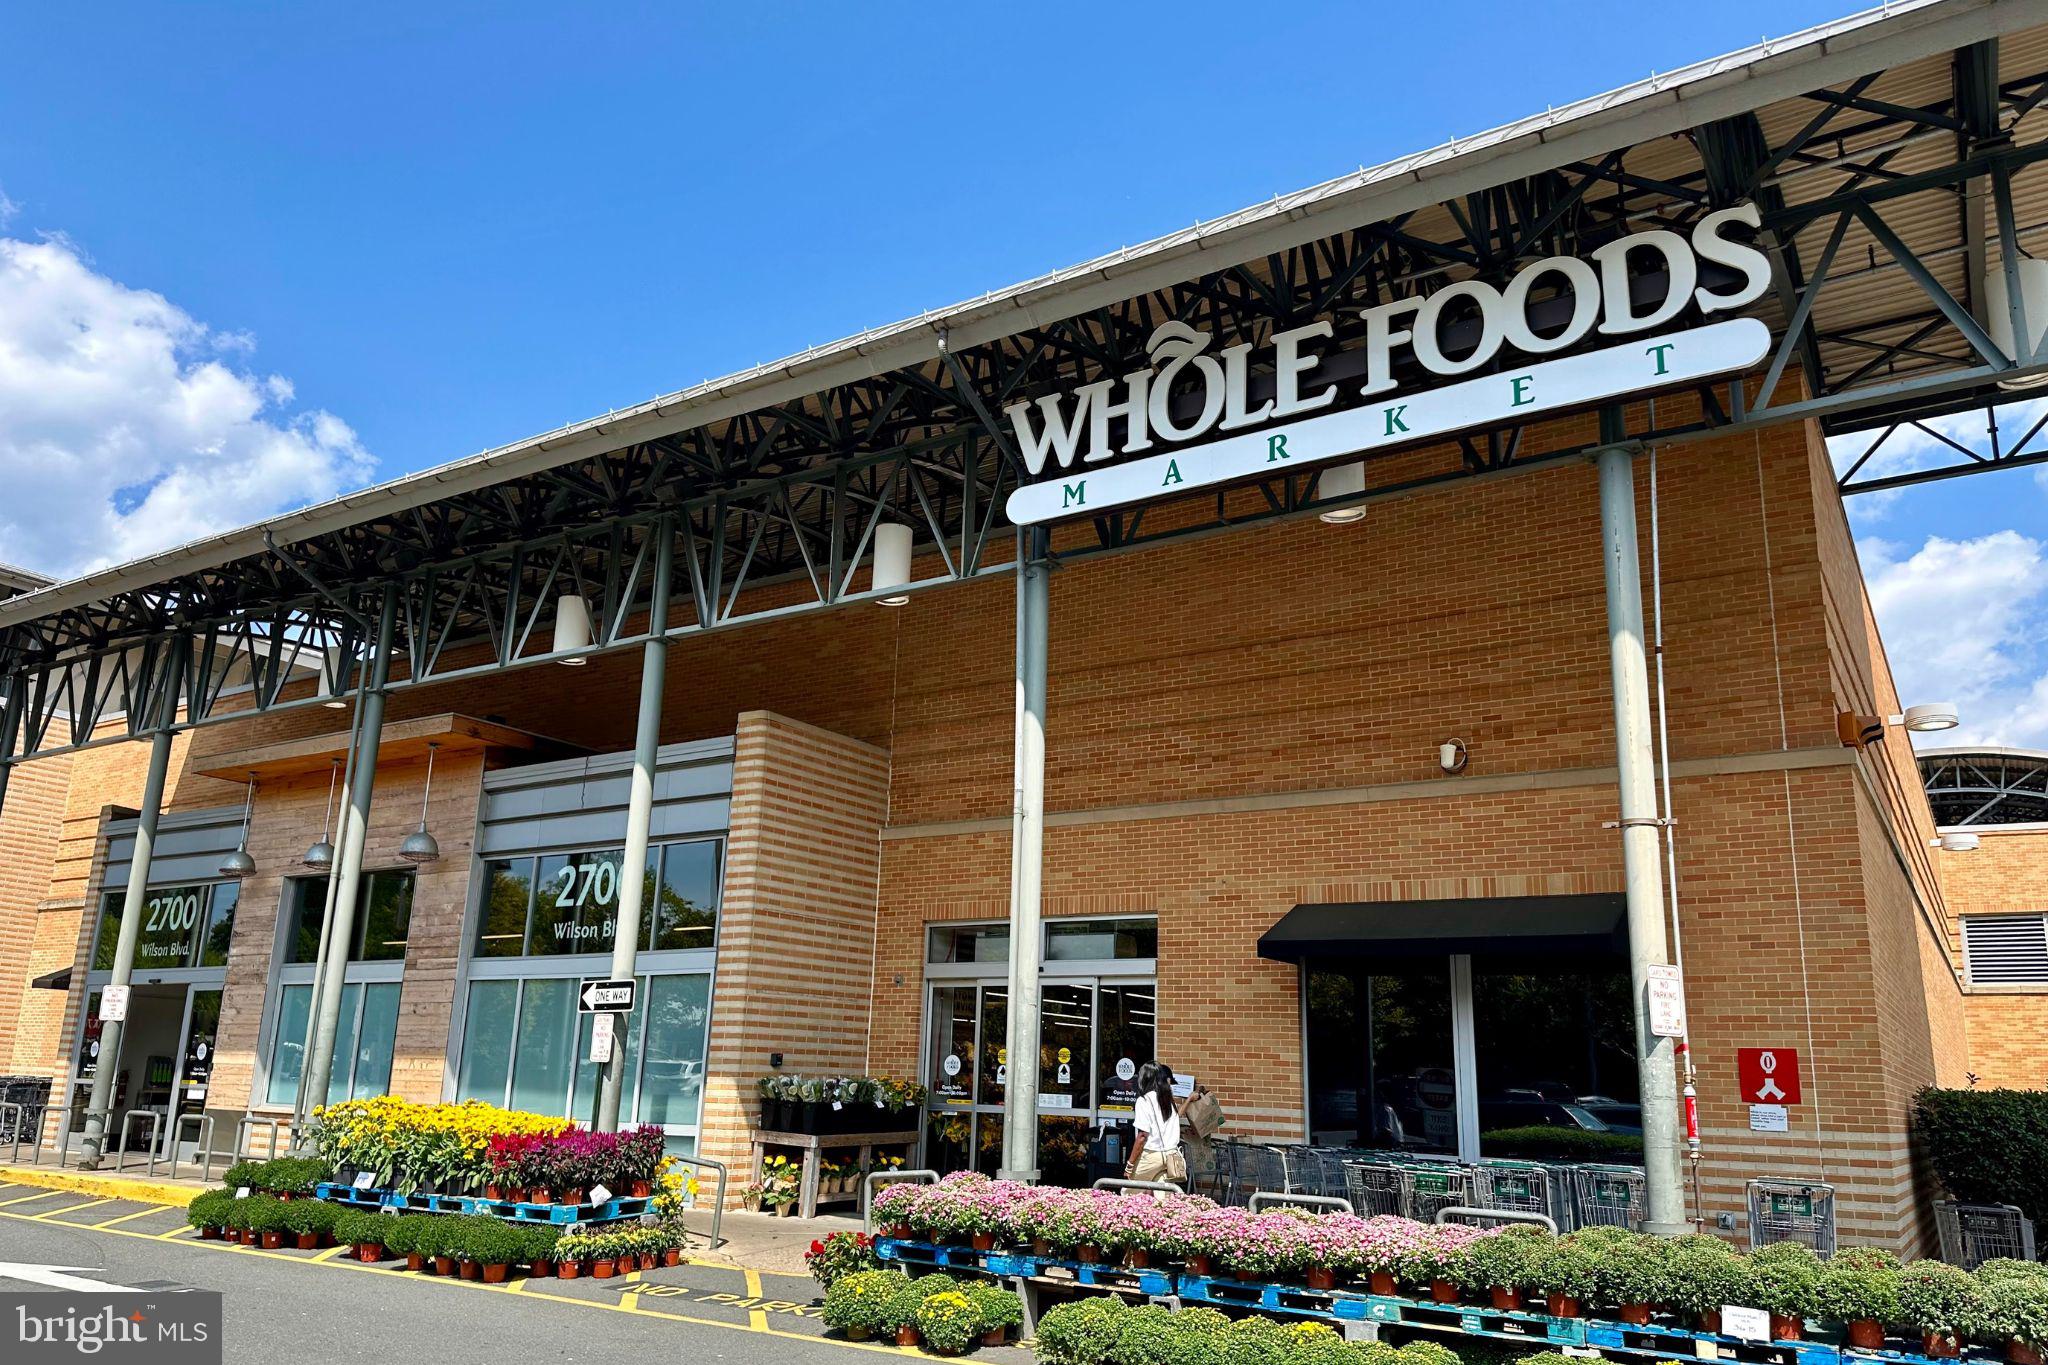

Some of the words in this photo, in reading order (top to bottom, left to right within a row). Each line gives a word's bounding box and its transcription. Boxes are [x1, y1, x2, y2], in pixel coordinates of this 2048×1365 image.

[1004, 321, 1337, 475] WHOLE
[1360, 202, 1773, 396] FOODS
[1062, 343, 1675, 509] MARKET
[145, 894, 198, 932] 2700
[553, 920, 598, 940] Wilson
[602, 918, 618, 938] Bl
[141, 942, 169, 957] Wilson
[170, 940, 190, 957] Blvd.
[595, 990, 610, 1002] ONE
[612, 989, 629, 1001] WAY
[1653, 990, 1677, 1001] PARKING
[617, 1282, 690, 1297] NO
